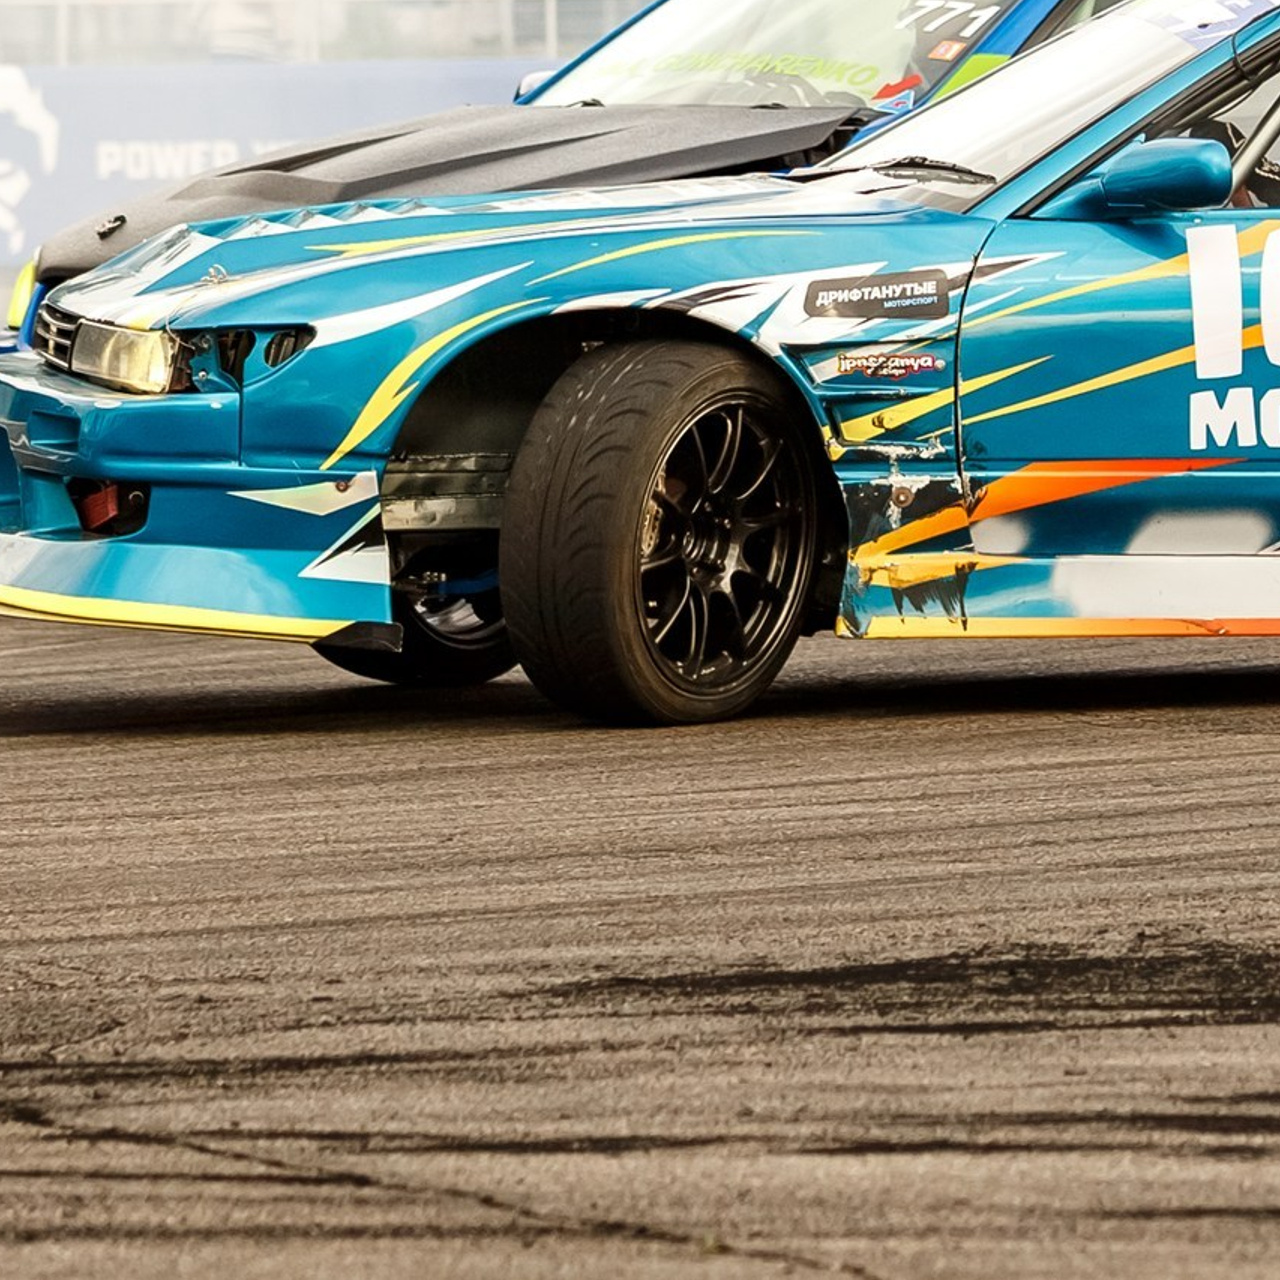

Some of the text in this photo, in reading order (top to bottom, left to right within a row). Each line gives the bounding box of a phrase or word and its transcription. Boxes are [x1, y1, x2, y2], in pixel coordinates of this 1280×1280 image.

[97, 140, 239, 180] POWER
[816, 281, 938, 307] ДРИФТАНУТЫЕ
[884, 296, 938, 308] МОТОРСПОРТ
